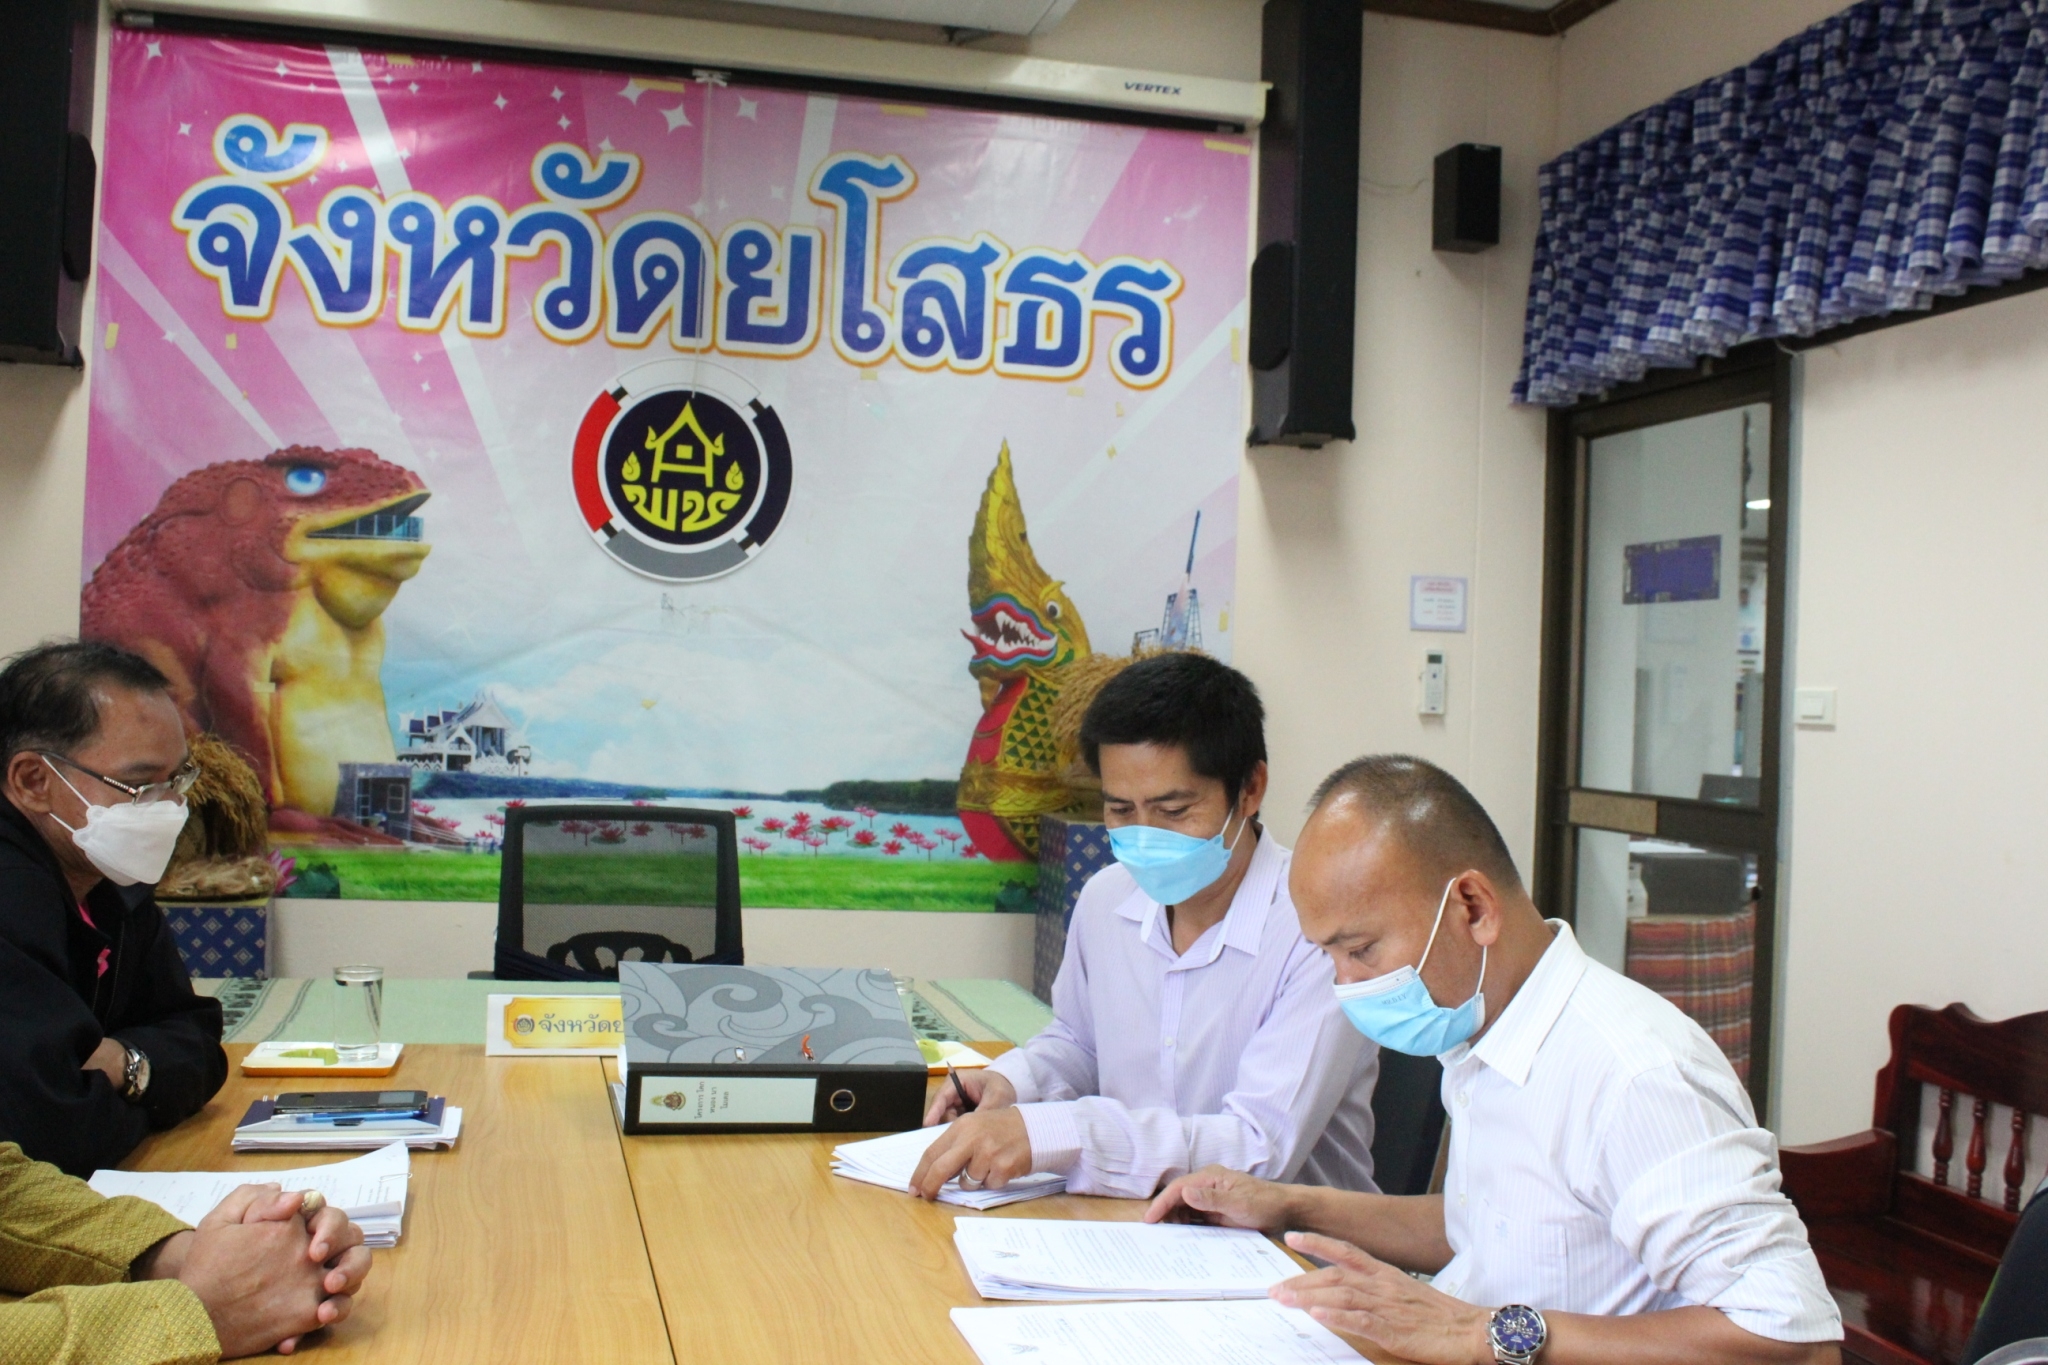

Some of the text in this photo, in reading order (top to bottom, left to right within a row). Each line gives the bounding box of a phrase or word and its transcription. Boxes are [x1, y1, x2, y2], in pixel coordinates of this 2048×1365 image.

[1125, 82, 1181, 95] VERTEX
[176, 117, 1180, 387] จังหวัดยโสธร
